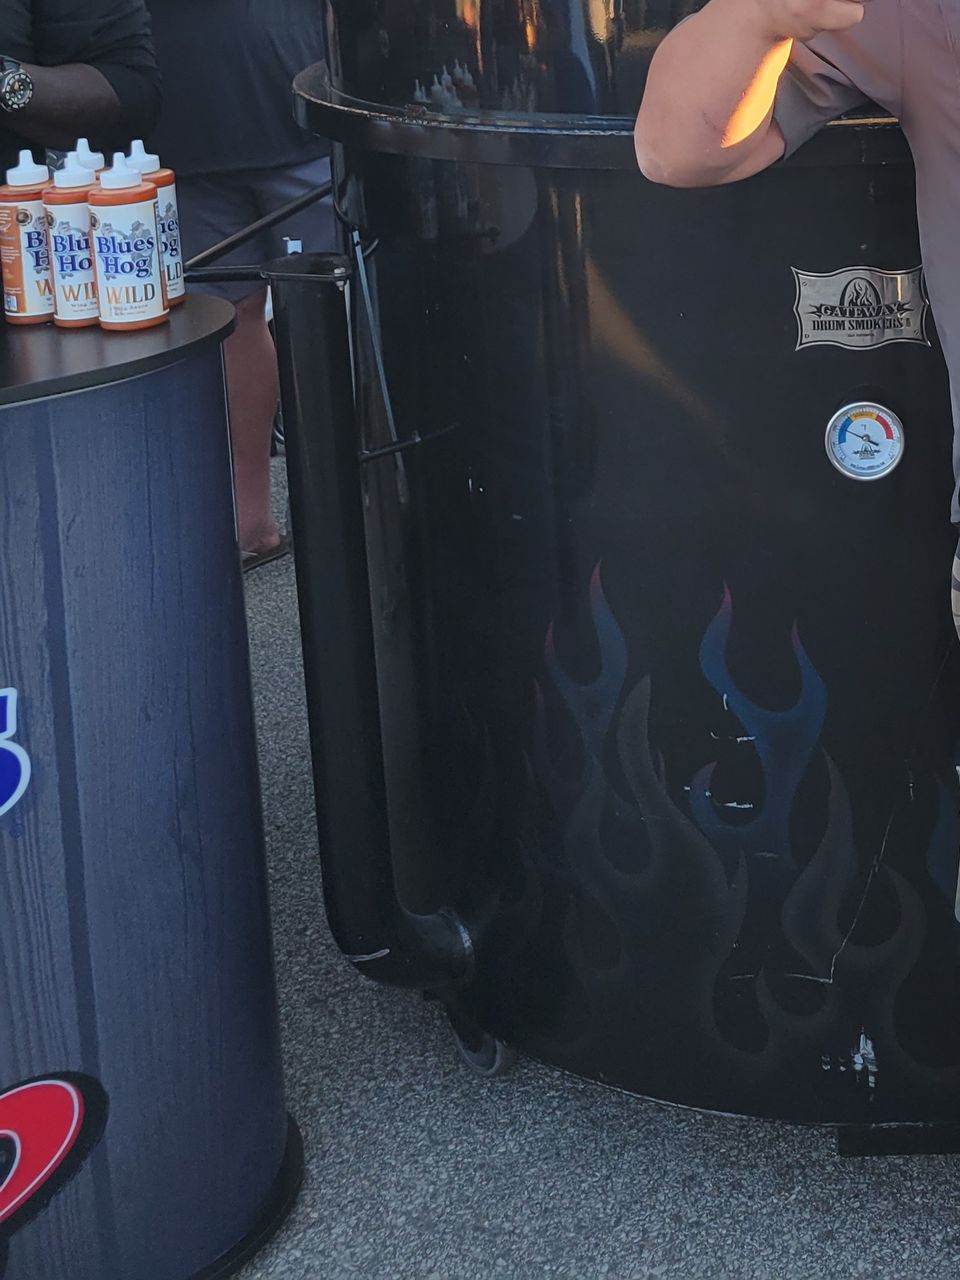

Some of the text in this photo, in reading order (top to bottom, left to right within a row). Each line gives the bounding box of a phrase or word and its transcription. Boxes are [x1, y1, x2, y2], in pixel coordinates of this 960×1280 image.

[53, 234, 90, 252] Blu
[96, 236, 154, 254] Blues
[58, 255, 92, 272] Ho
[104, 256, 150, 278] Hog
[105, 283, 155, 304] WILD
[821, 303, 899, 318] GATEWAY
[812, 319, 846, 331] DRUM
[848, 317, 904, 331] SMOKERS
